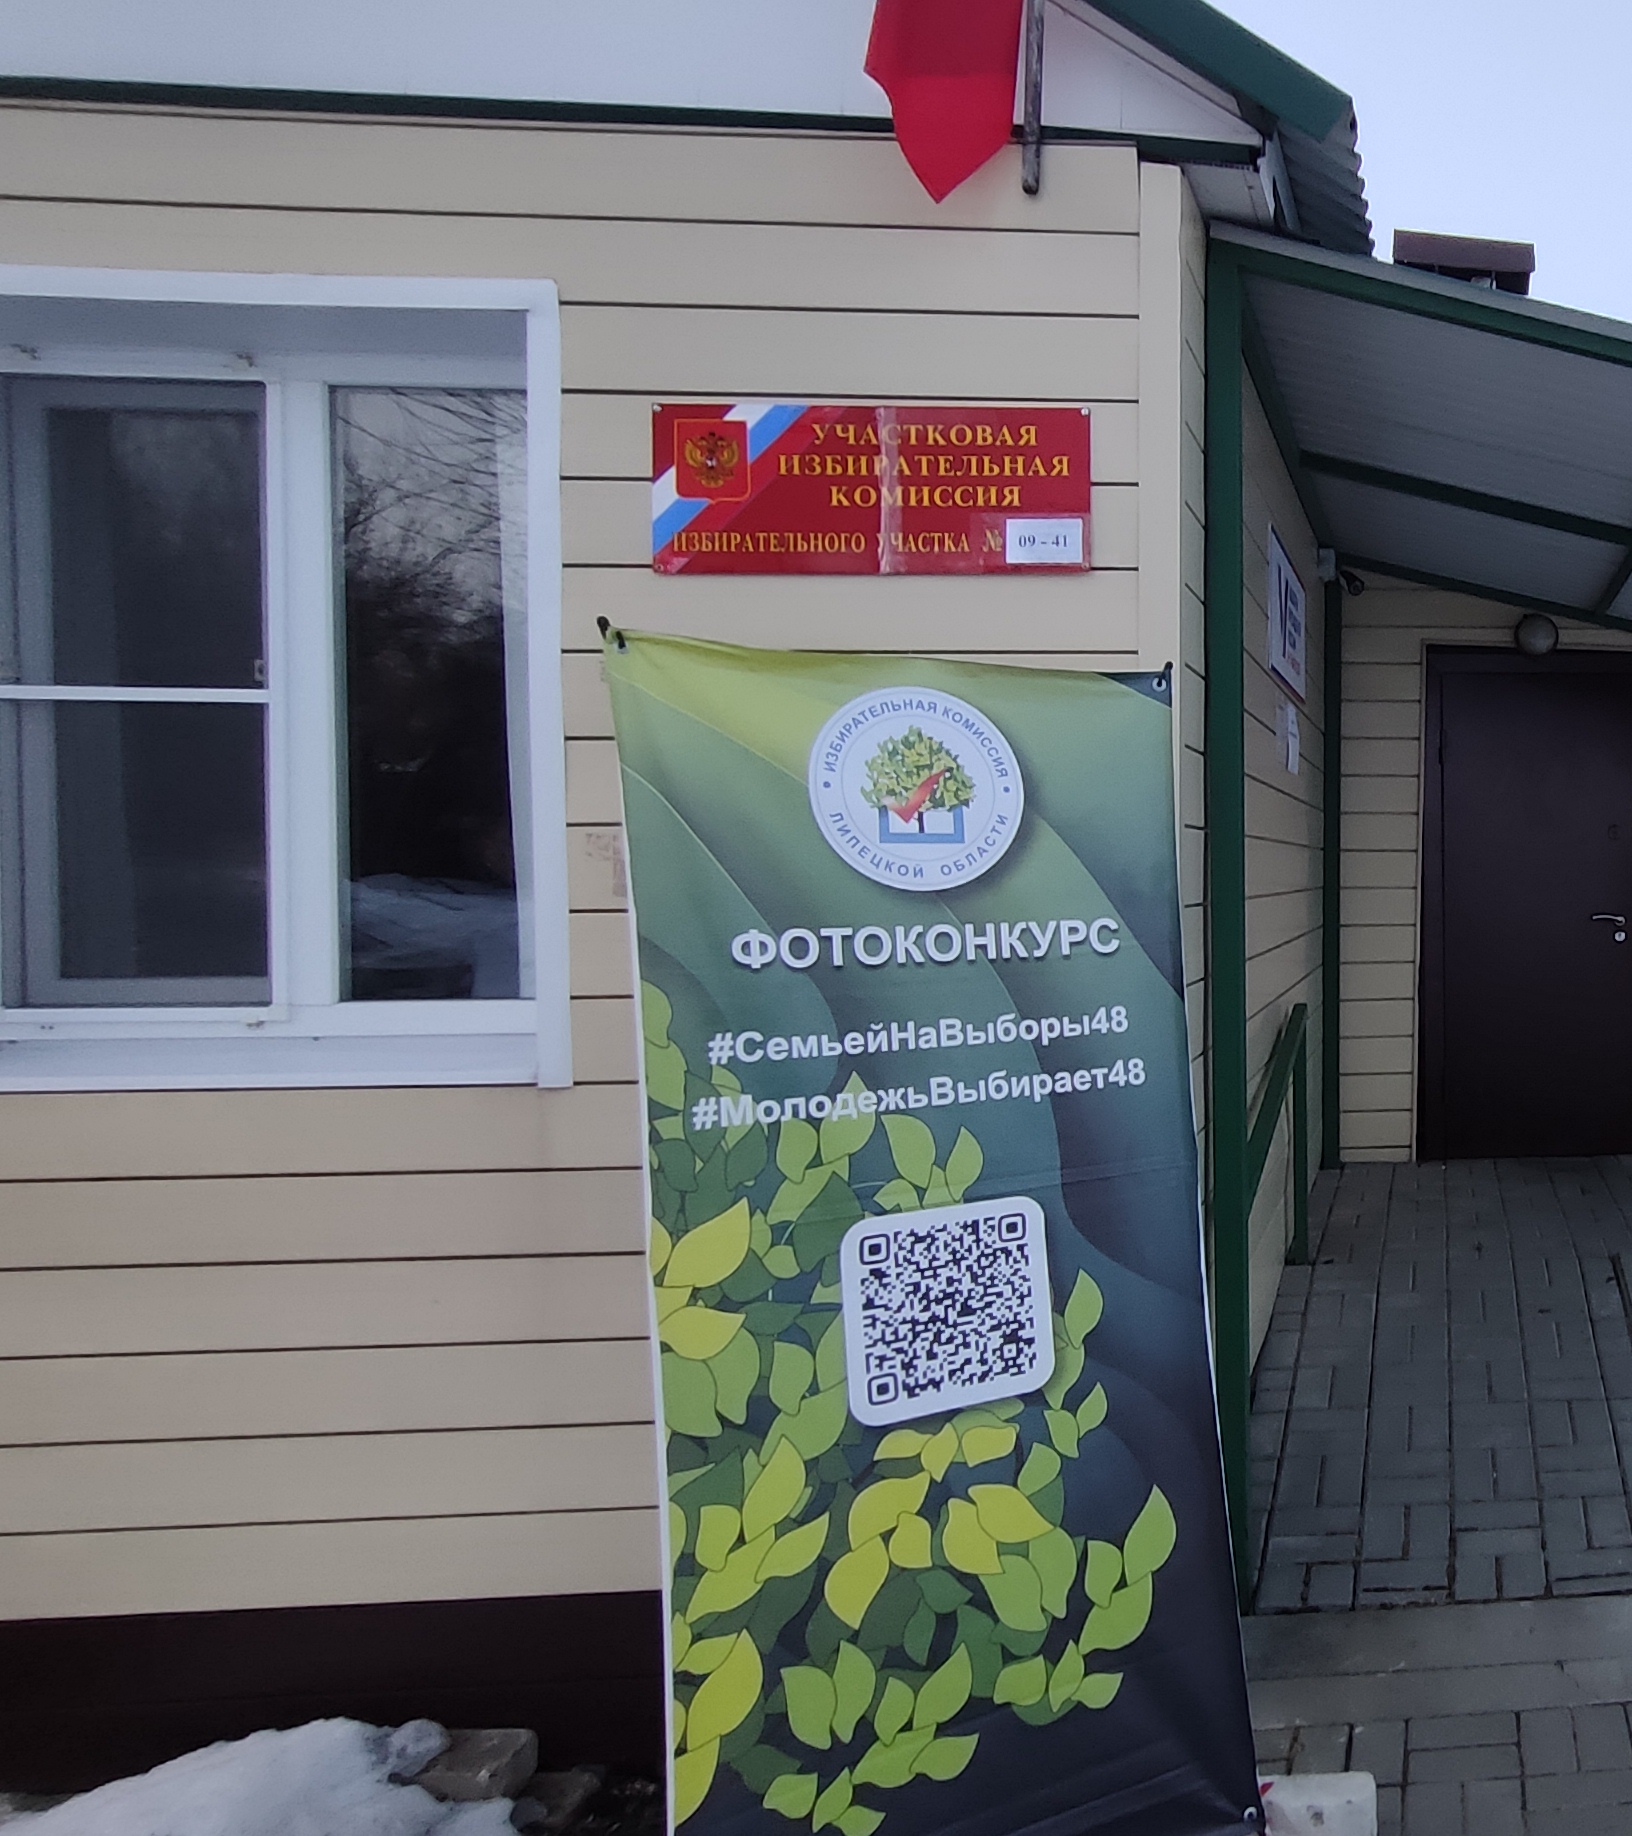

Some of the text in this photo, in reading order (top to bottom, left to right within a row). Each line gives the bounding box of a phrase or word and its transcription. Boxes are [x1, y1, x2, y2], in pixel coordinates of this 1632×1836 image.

[811, 423, 1039, 447] УЧАСТКОВАЯ
[778, 454, 1071, 477] ИЗБИРАТЕЛЬНАЯ
[829, 485, 1022, 508] КОМИССИЯ
[672, 531, 866, 553] ИЗБИРАТЕЛЬНОГО
[877, 531, 970, 554] УЧАСТКА
[1018, 534, 1036, 548] 09
[1051, 534, 1068, 548] 41
[823, 699, 1009, 779] ИЗБИРАТЕЛЬНАЯ КОМИССИЯ
[829, 811, 1009, 879] ЛИПЕЦКОЙ ОБЛАСТИ
[731, 917, 1121, 970] ФОТОКОНКУРС
[707, 1005, 1130, 1066] #СемьейНаВыборы48
[691, 1057, 1147, 1132] #МолодежьВыбирает48
